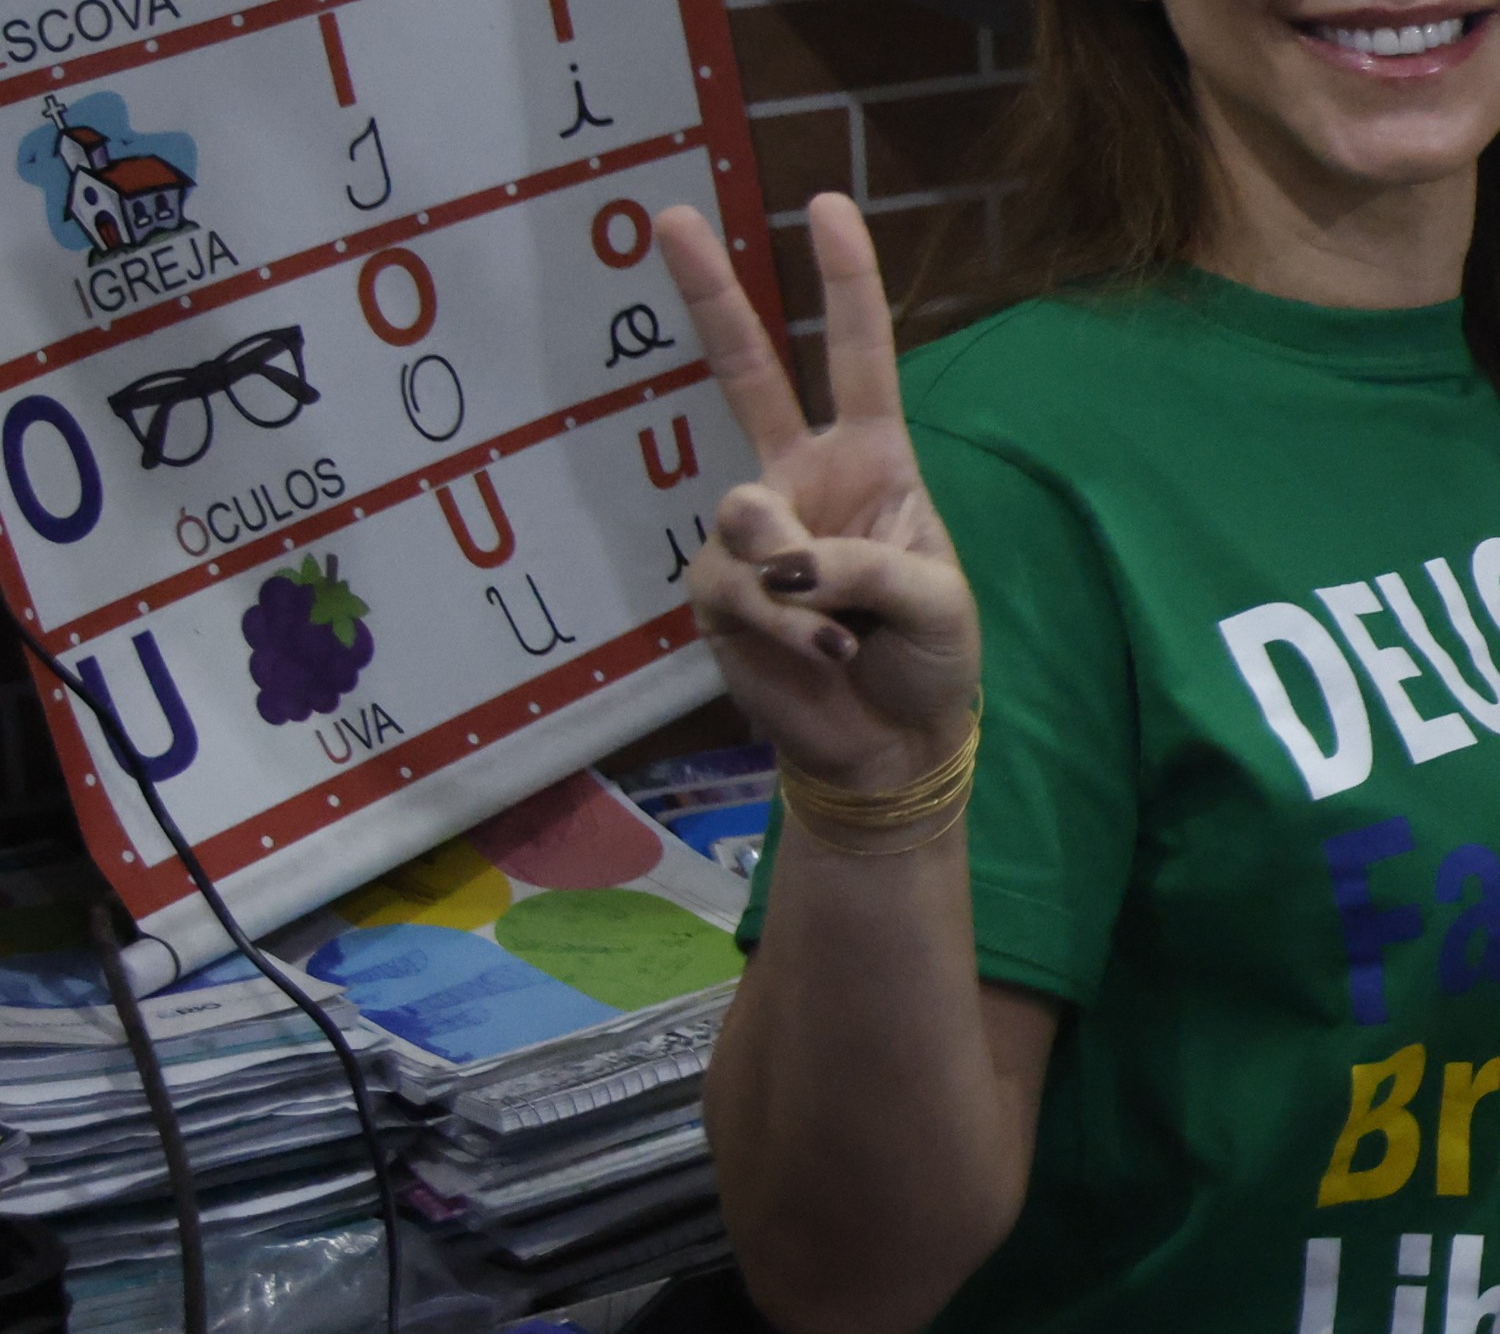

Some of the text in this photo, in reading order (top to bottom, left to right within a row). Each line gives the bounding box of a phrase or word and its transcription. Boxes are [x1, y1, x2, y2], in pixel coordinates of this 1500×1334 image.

[318, 12, 357, 108] I
[560, 63, 613, 139] i
[74, 229, 239, 319] IGREJA
[591, 198, 652, 269] o
[358, 247, 437, 347] O
[401, 354, 464, 442] O
[2, 394, 103, 544] O
[637, 414, 698, 490] u
[175, 457, 346, 557] ÓCULOS
[435, 469, 516, 569] U
[74, 629, 199, 783] U
[315, 701, 405, 765] UVA
